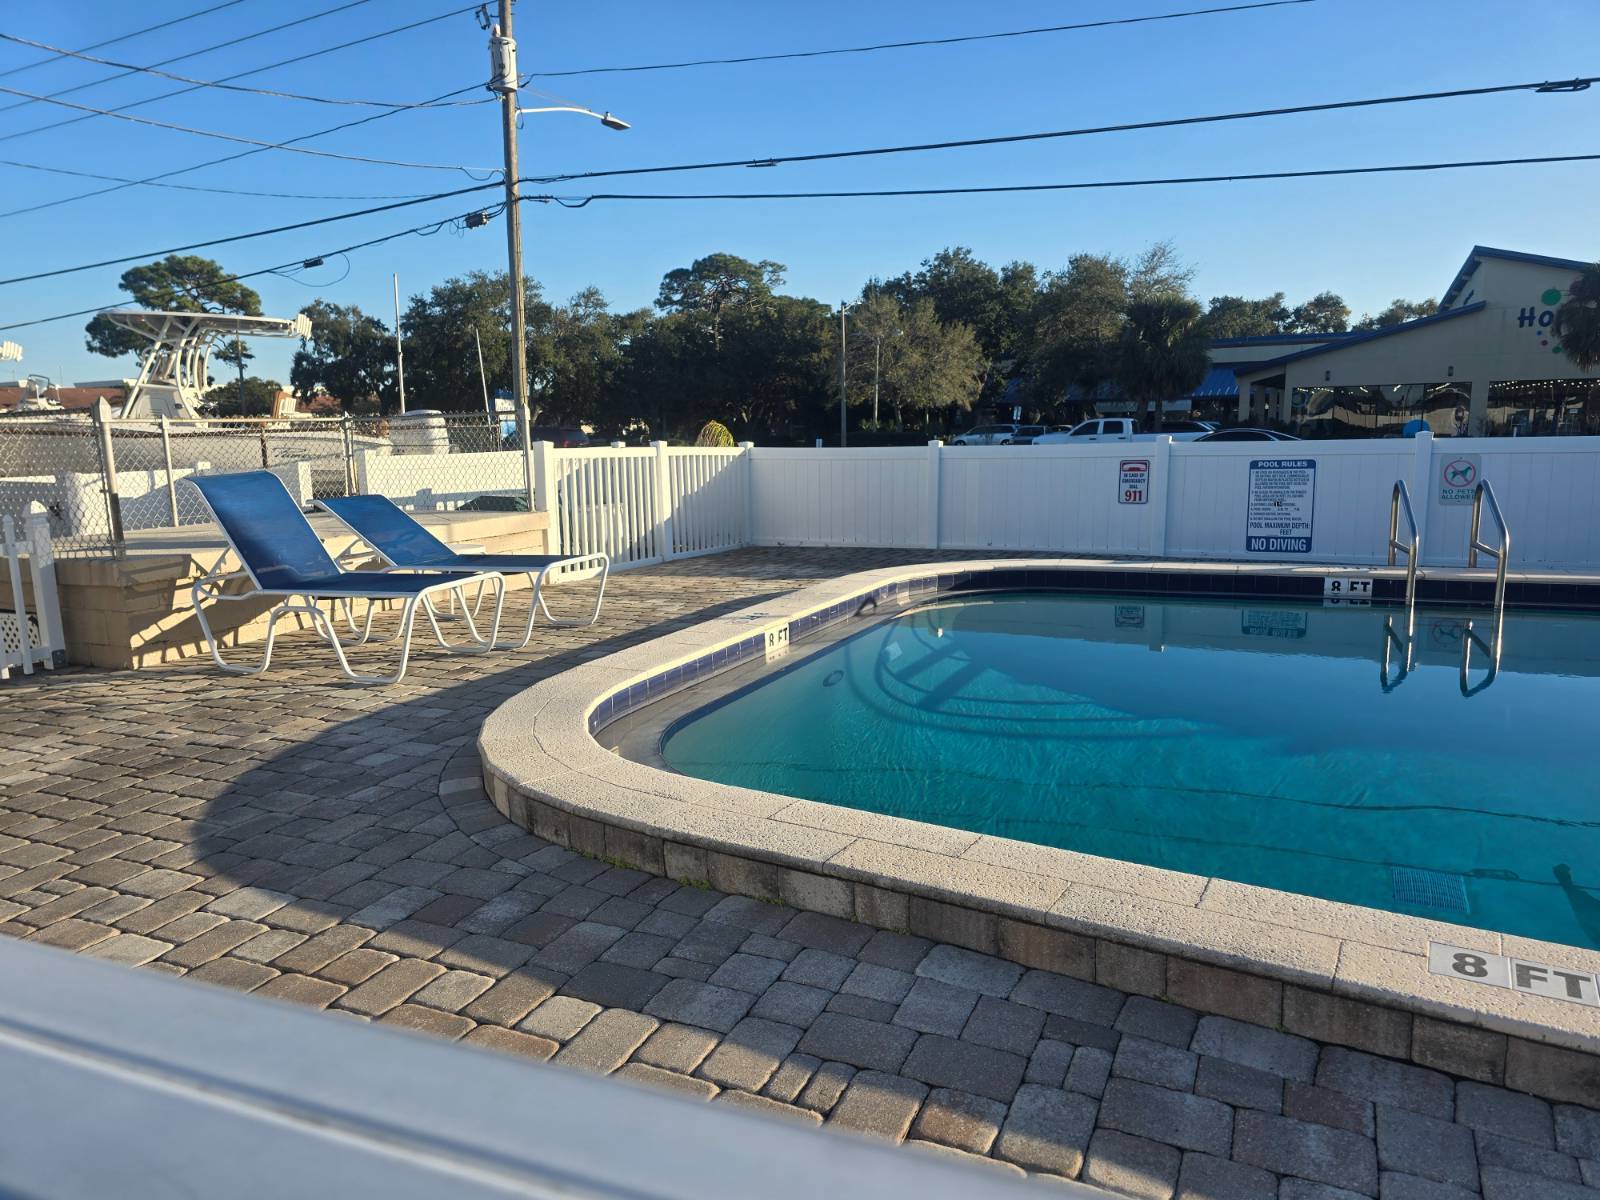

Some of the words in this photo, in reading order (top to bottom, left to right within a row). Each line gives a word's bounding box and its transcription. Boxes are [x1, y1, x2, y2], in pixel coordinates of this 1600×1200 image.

[1125, 490, 1142, 501] 911
[1251, 538, 1266, 550] NO
[1269, 538, 1307, 551] DIVING
[1331, 580, 1341, 594] 8
[1349, 581, 1370, 592] FT
[769, 633, 774, 646] 8
[778, 627, 788, 642] FT
[1451, 953, 1488, 978] 8
[1515, 963, 1591, 999] FT
